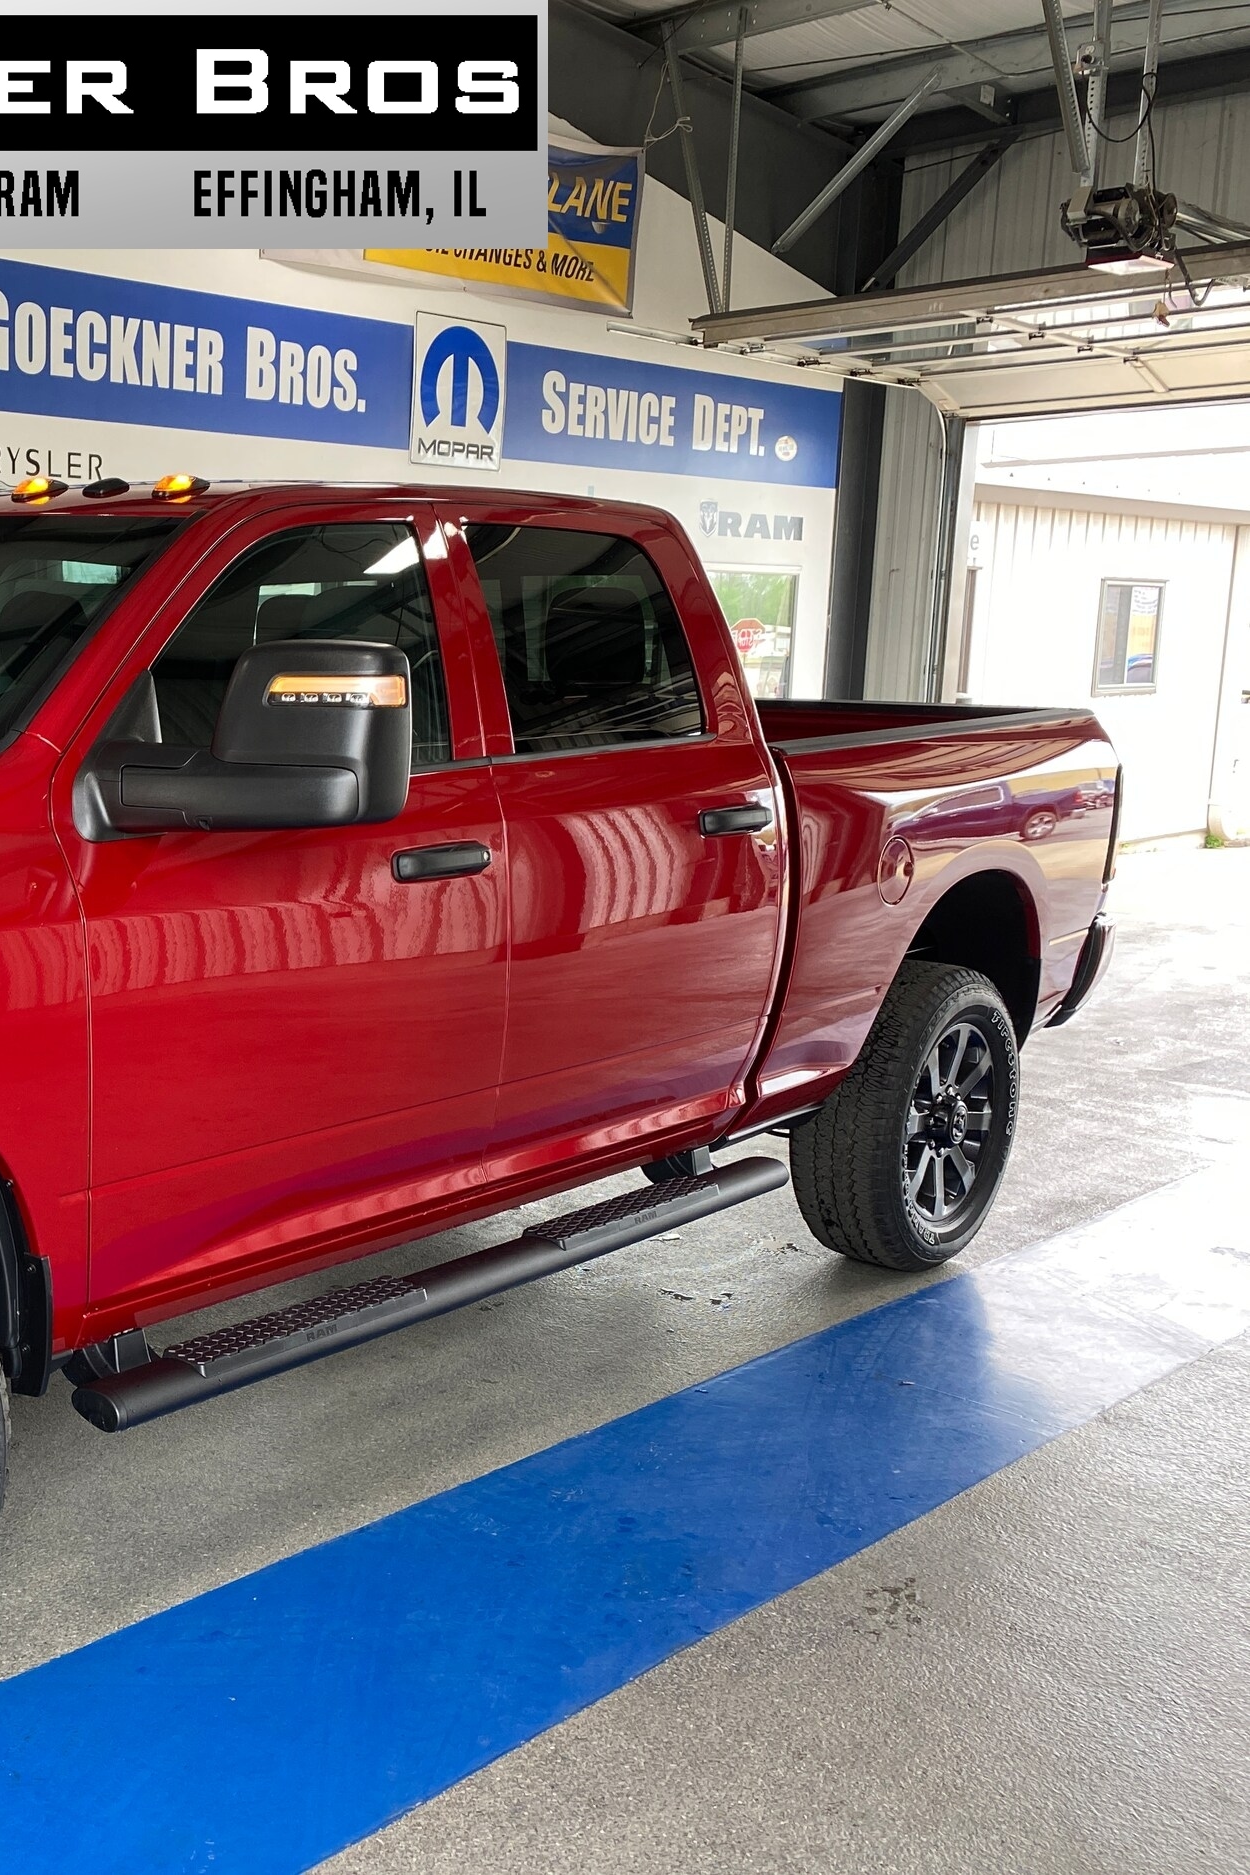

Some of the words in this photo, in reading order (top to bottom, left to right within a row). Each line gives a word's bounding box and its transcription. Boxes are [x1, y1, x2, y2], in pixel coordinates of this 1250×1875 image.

[548, 172, 632, 223] LANE
[536, 250, 547, 273] &
[551, 253, 595, 282] MORE
[418, 437, 494, 461] MOPAR
[718, 511, 804, 541] RAM
[634, 1210, 658, 1225] RAM
[306, 1323, 338, 1342] RAM
